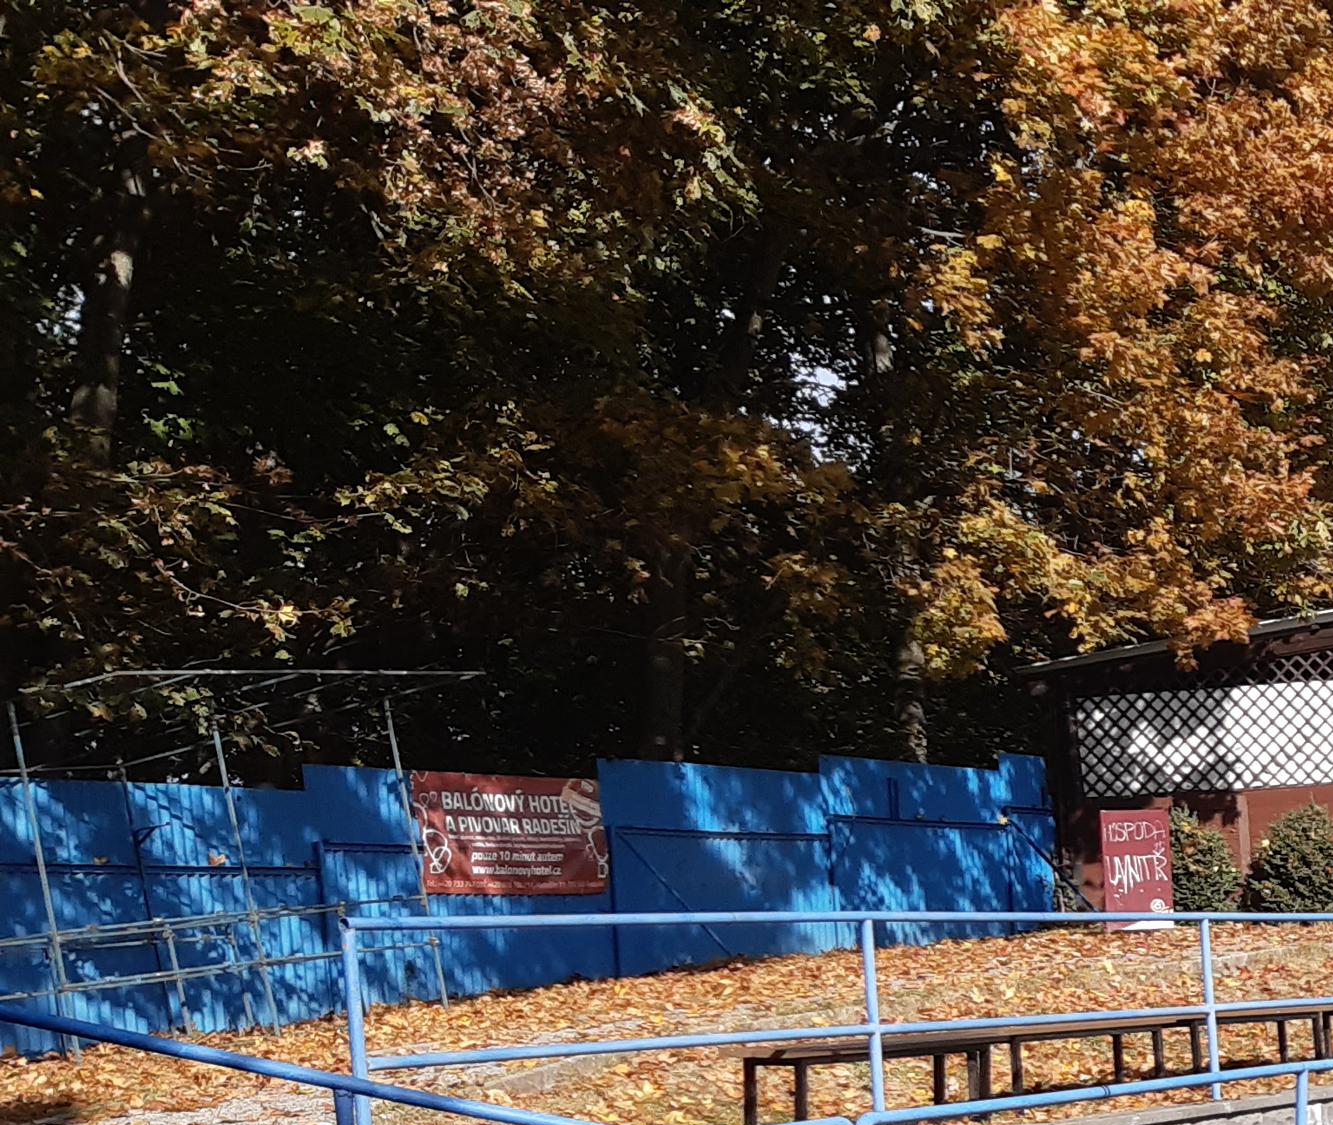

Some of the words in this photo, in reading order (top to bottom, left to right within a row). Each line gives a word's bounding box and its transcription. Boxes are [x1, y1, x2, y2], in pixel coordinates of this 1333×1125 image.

[441, 785, 525, 813] BALÓNOVÝ
[446, 816, 456, 833] A
[459, 816, 522, 834] PIVOVAR
[471, 851, 498, 863] pouze
[500, 850, 511, 861] 10
[511, 850, 536, 861] minut
